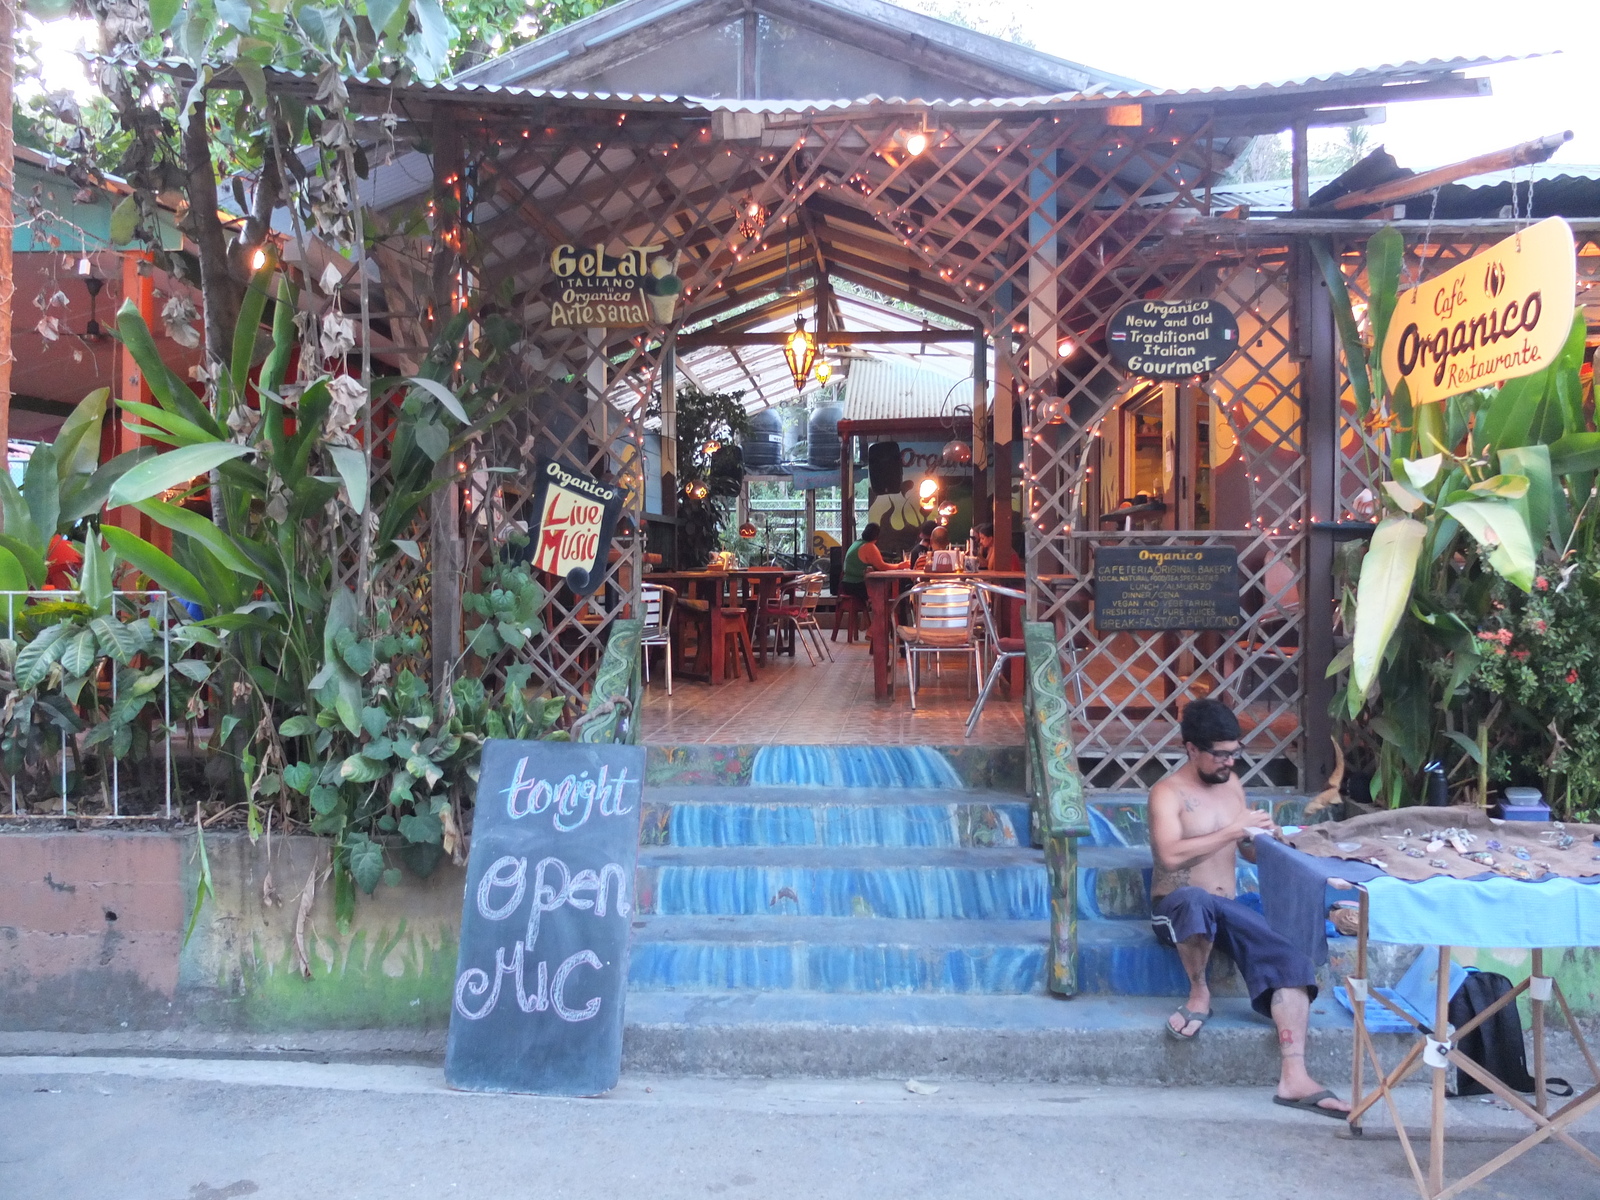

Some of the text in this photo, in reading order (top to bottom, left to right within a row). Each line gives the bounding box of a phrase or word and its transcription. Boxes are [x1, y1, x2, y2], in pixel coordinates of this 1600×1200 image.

[560, 278, 634, 289] ITALIANO
[562, 289, 631, 306] Organico
[1434, 274, 1467, 320] Café
[551, 288, 650, 326] Artesanal
[1144, 301, 1209, 319] Organico
[1126, 312, 1213, 327] New and Old
[1130, 328, 1209, 343] Traditional
[1397, 290, 1542, 387] Organico
[1143, 344, 1196, 356] Italian
[1128, 356, 1217, 374] Gourmet
[1447, 338, 1542, 389] Restaurante
[546, 462, 613, 500] Organico
[544, 492, 602, 528] Live
[535, 528, 598, 575] Music
[1138, 550, 1203, 566] Organico
[1198, 565, 1232, 574] BAKERY
[1163, 608, 1184, 616] PURE
[1186, 608, 1216, 616] JUICES
[500, 756, 639, 832] tonight
[478, 856, 630, 952] Open
